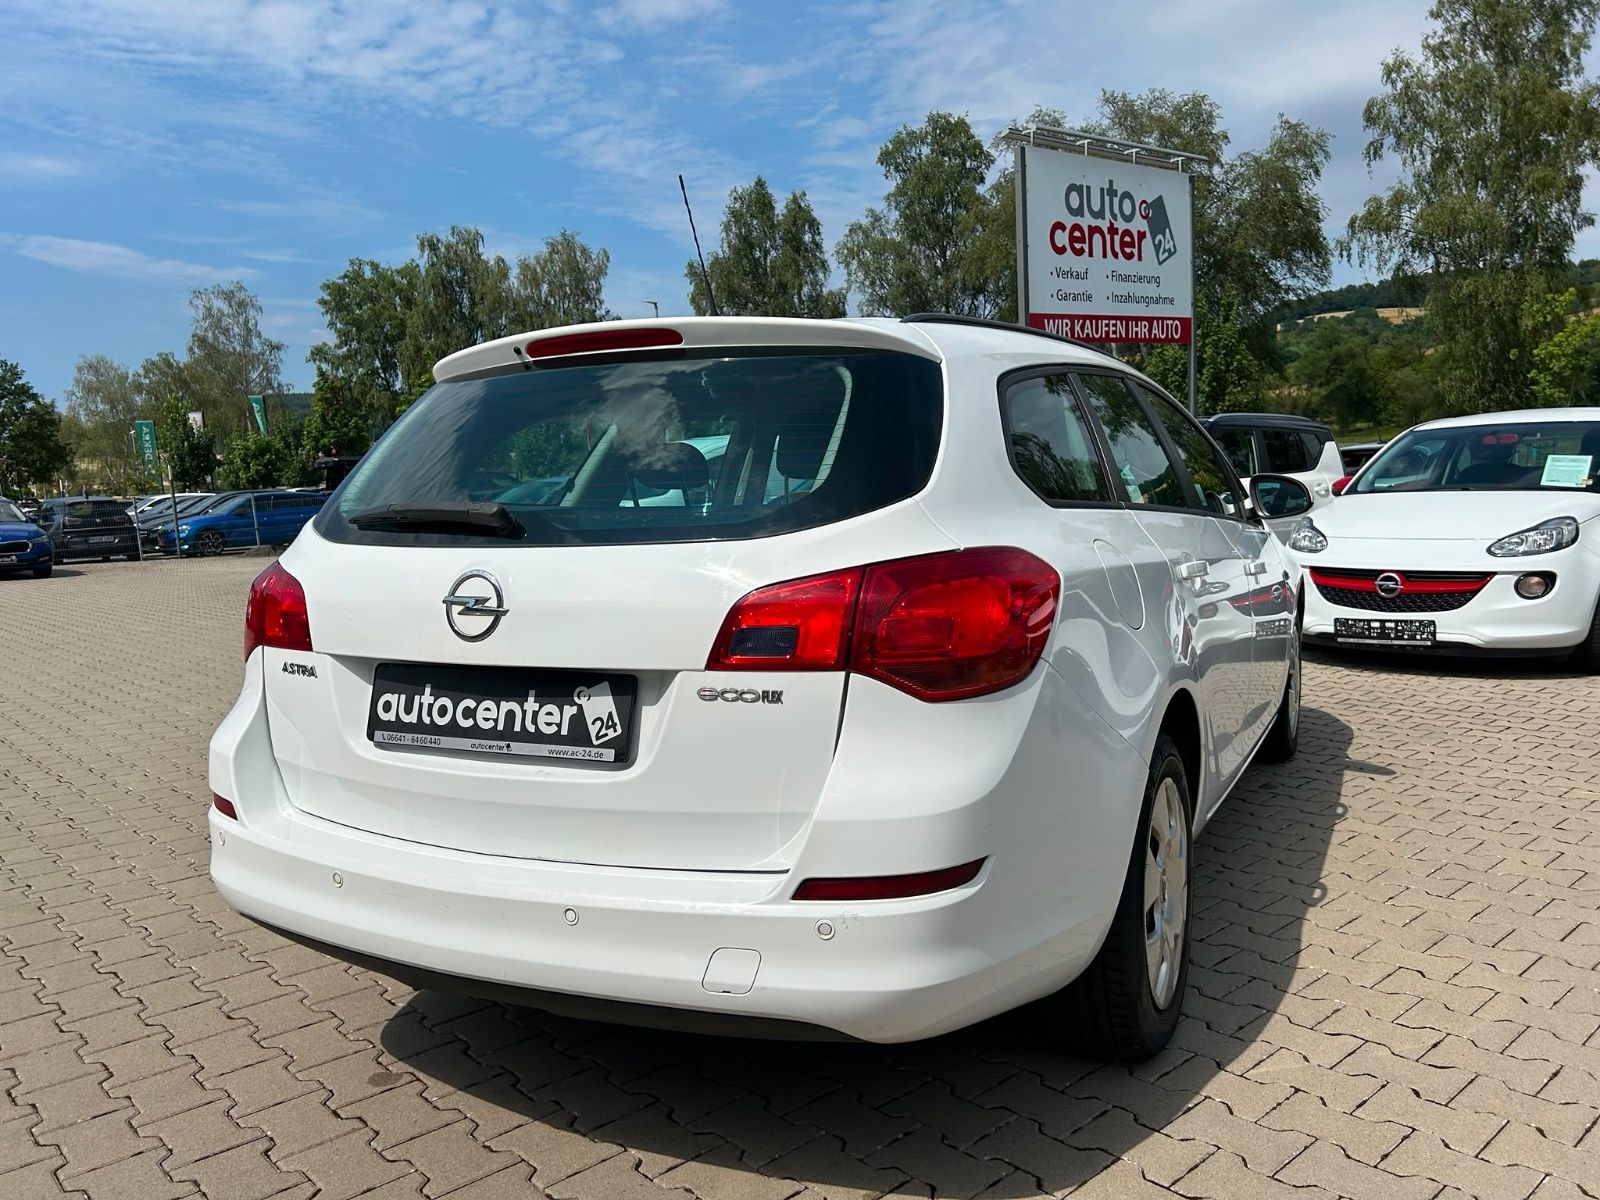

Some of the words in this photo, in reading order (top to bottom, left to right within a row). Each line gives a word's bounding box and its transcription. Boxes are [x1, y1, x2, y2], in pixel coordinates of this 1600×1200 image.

[1064, 179, 1136, 223] auto
[1049, 219, 1146, 261] center
[1155, 228, 1174, 261] 24
[1055, 267, 1088, 280] Verkauf
[1111, 271, 1160, 287] Finanzierung
[1056, 289, 1093, 302] Garantie
[1111, 292, 1175, 307] Inzahlungnahme
[1044, 318, 1071, 338] WIR
[1074, 319, 1125, 338] KAUFEN
[1128, 320, 1149, 338] IHR
[1151, 320, 1181, 339] AUTO
[281, 661, 318, 678] ASTRA
[591, 713, 618, 742] 24
[470, 743, 505, 751] autocenter
[547, 748, 604, 759] www.ac-24.de
